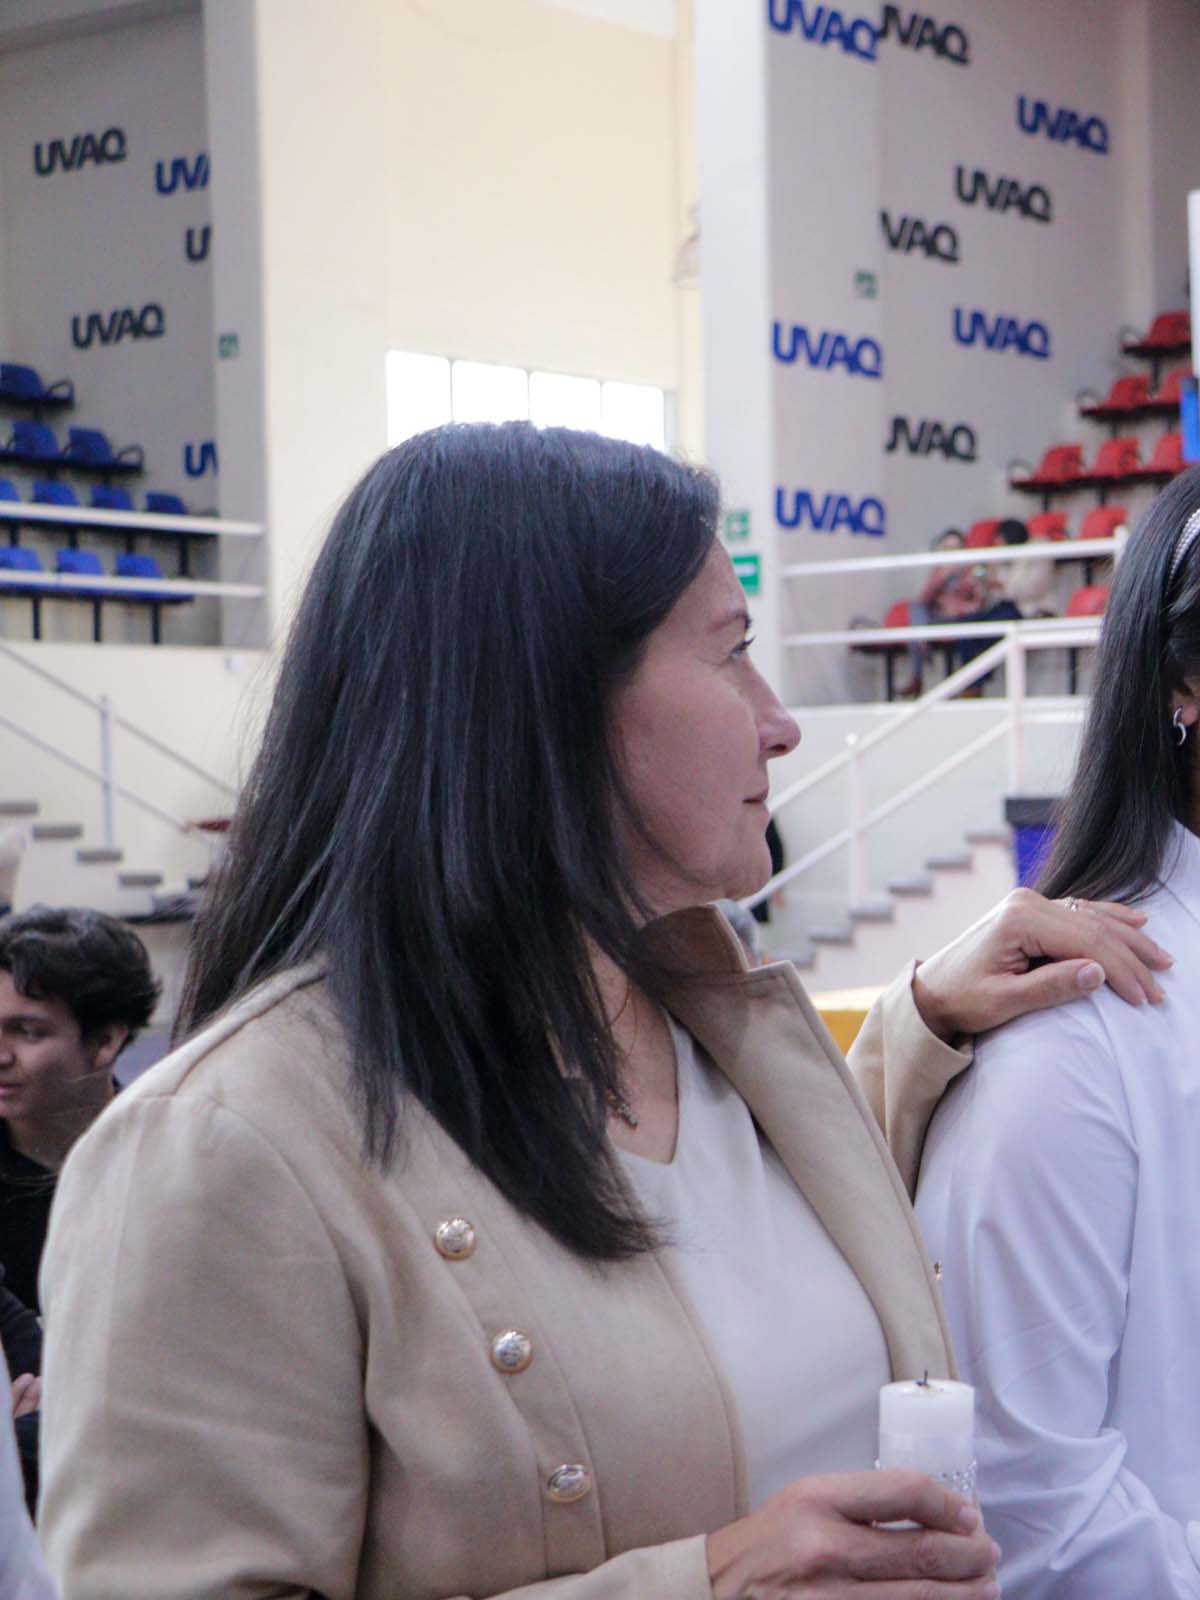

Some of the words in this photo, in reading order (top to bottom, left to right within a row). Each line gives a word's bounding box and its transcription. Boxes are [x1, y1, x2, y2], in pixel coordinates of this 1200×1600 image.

[767, 0, 876, 62] UVAQ
[34, 127, 126, 177] UVAQ
[1017, 95, 1109, 155] UVAQ
[954, 165, 1052, 224] UVAQ
[72, 303, 165, 350] UVAQ
[772, 321, 883, 379] UVAQ
[953, 308, 1050, 360] UVAQ
[775, 488, 886, 538] UVAQ
